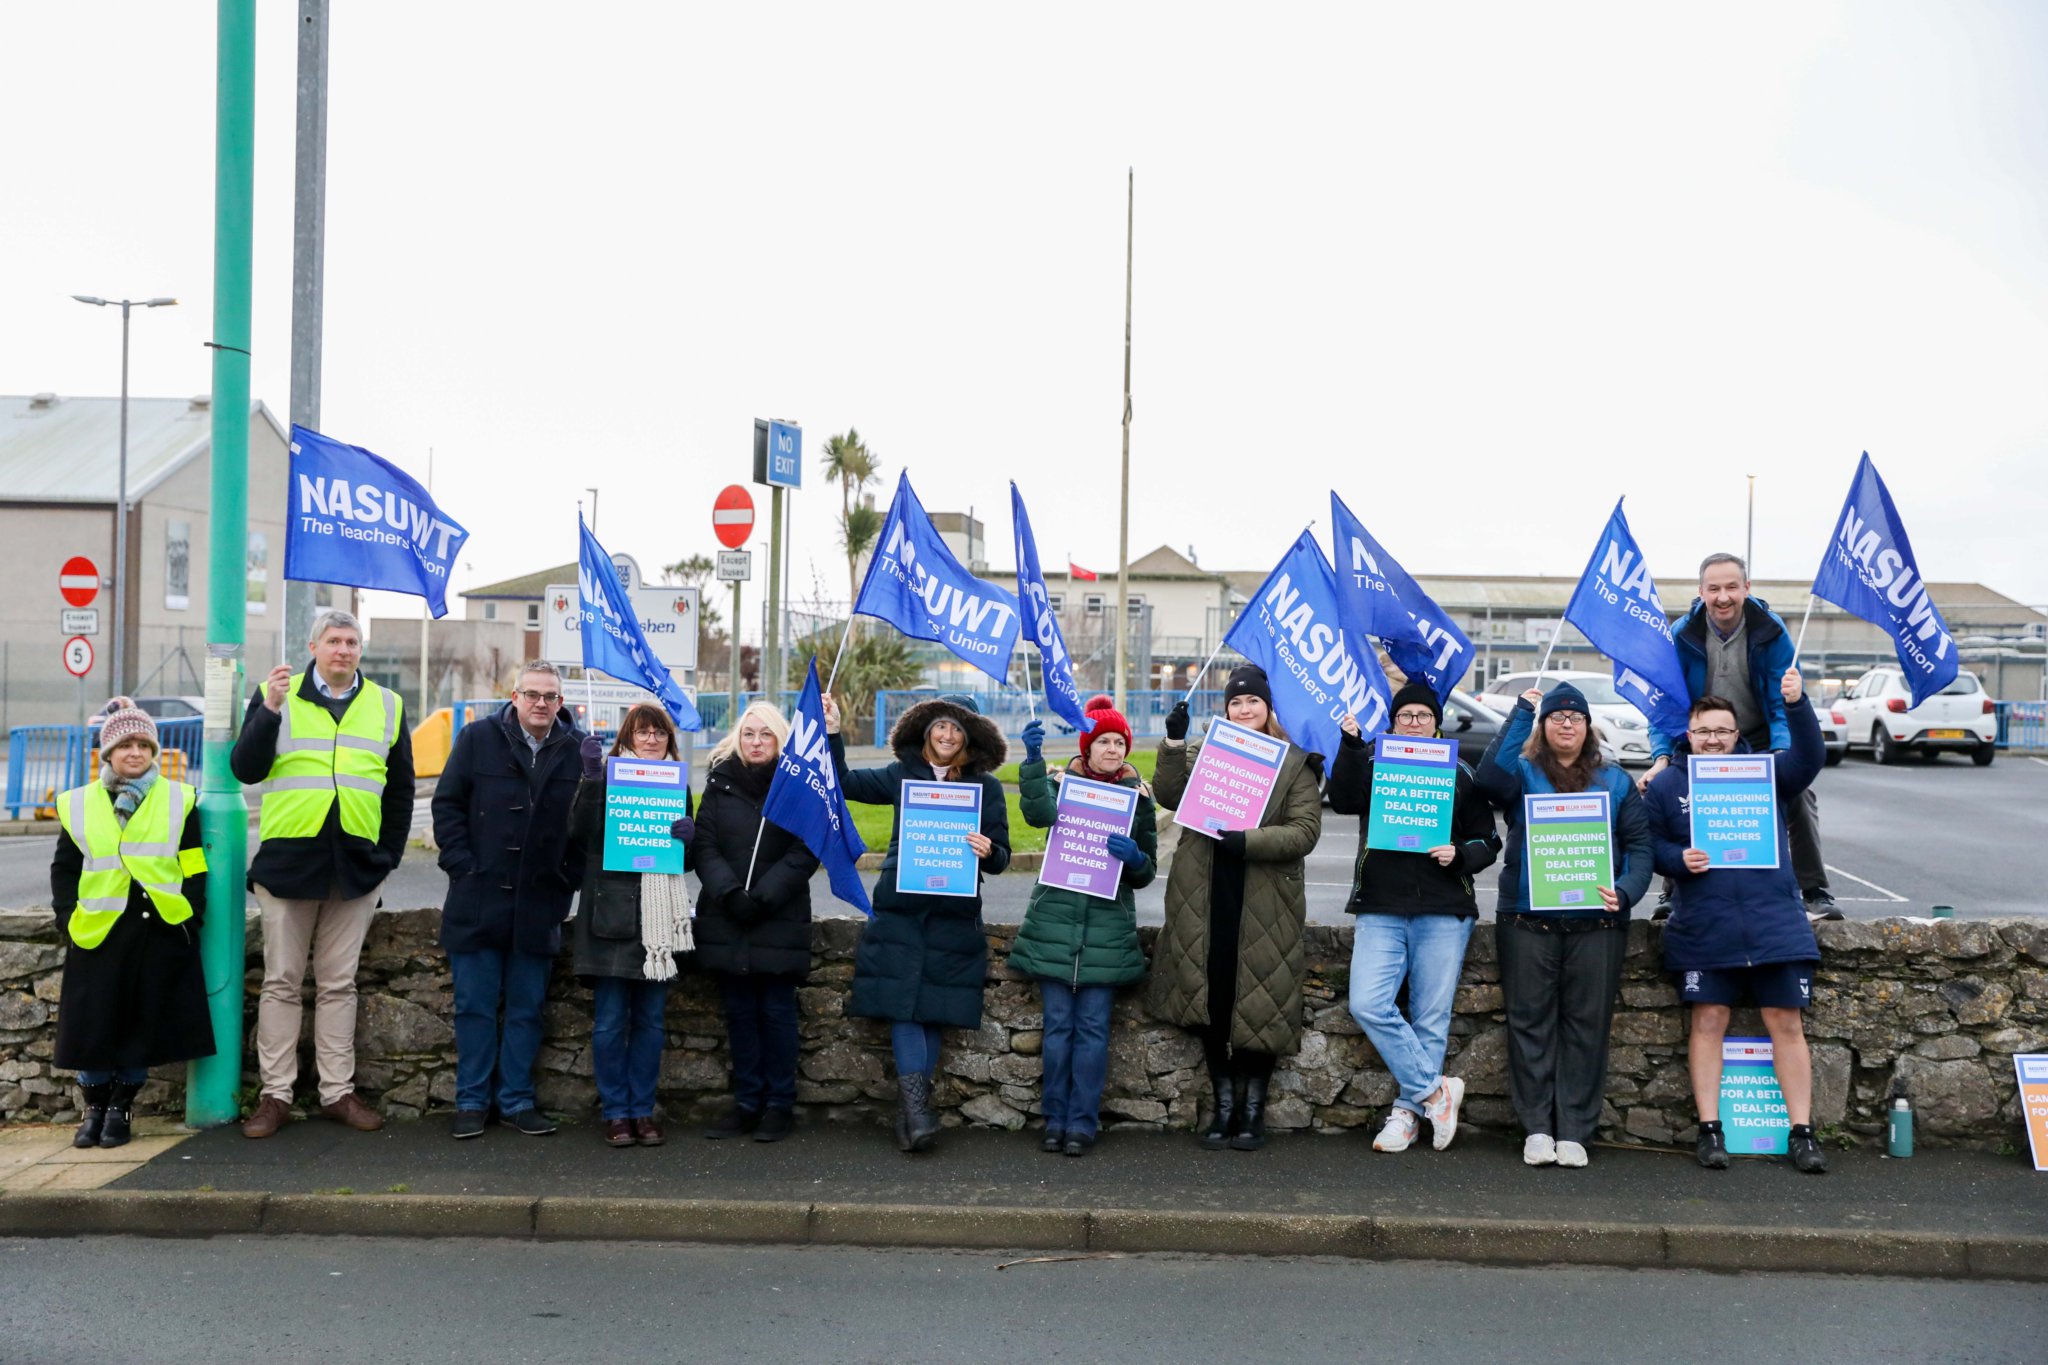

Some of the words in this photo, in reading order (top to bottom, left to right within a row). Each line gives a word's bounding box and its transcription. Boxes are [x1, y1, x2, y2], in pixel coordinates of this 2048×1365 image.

[778, 434, 792, 454] NO
[775, 456, 794, 476] EXIT
[299, 473, 462, 560] NASUWT
[301, 517, 334, 535] The
[720, 555, 747, 566] Except
[722, 566, 744, 576] buses
[882, 556, 905, 582] The
[1353, 574, 1384, 592] The
[1594, 575, 1618, 605] The
[1623, 596, 1675, 646] Teache
[641, 619, 676, 633] shen
[949, 629, 998, 656] Union
[74, 648, 82, 664] 5
[1258, 604, 1276, 638] The
[1274, 637, 1333, 705] Teachers'
[1266, 573, 1387, 732] NASUWT
[1050, 666, 1083, 708] Unio
[1202, 755, 1270, 787] CAMPAIGNING
[1200, 768, 1220, 781] FOR
[1220, 776, 1226, 784] A
[1229, 779, 1264, 798] BETTER
[1374, 772, 1453, 787] CAMPAIGNING
[1204, 784, 1228, 799] DEAL
[1230, 792, 1250, 806] FOR
[1375, 786, 1397, 796] FOR
[1399, 788, 1408, 797] A
[1410, 789, 1450, 800] BETTER
[1695, 794, 1770, 802] CAMPAIGNING
[608, 794, 684, 808] CAMPAIGNING
[1199, 795, 1246, 819] TEACHERS
[1385, 801, 1412, 812] DEAL
[1415, 804, 1438, 814] FOR
[609, 808, 631, 818] FOR
[633, 810, 641, 819] A
[643, 811, 682, 822] BETTER
[1697, 806, 1718, 815] FOR
[1721, 806, 1728, 815] A
[1730, 806, 1769, 815] BETTER
[905, 819, 976, 831] CAMPAIGNING
[1058, 814, 1126, 835] CAMPAIGNING
[1382, 814, 1438, 828] TEACHERS
[1708, 819, 1735, 828] DEAL
[1737, 819, 1758, 828] FOR
[620, 823, 646, 833] DEAL
[649, 825, 671, 835] FOR
[1056, 826, 1077, 838] FOR
[1078, 832, 1084, 840] A
[1087, 832, 1108, 844] BETT
[1707, 832, 1761, 840] TEACHERS
[617, 836, 672, 848] TEACHERS
[906, 832, 926, 841] FOR
[928, 833, 936, 842] A
[937, 834, 967, 844] BETTE
[1532, 832, 1606, 844] CAMPAIGNING
[916, 846, 940, 854] DEAL
[942, 847, 963, 856] FOR
[1064, 841, 1088, 853] DEAL
[1090, 846, 1108, 858] FOR
[1534, 847, 1556, 856] FOR
[1557, 847, 1566, 856] A
[1568, 846, 1605, 855] BETTER
[913, 858, 964, 869] TEACHERS
[1060, 852, 1108, 870] TEACHERS
[1546, 860, 1572, 869] DEAL
[1574, 860, 1596, 868] FOR
[1544, 872, 1598, 882] TEACHERS
[1720, 1075, 1778, 1086] CAMPAIGN
[1721, 1089, 1744, 1099] FOR
[1746, 1090, 1755, 1099] A
[1757, 1090, 1782, 1100] BETT
[1733, 1103, 1762, 1113] DEAL
[1764, 1104, 1788, 1114] FOR
[2032, 1108, 2048, 1116] FO
[1732, 1118, 1790, 1128] TEACHERS
